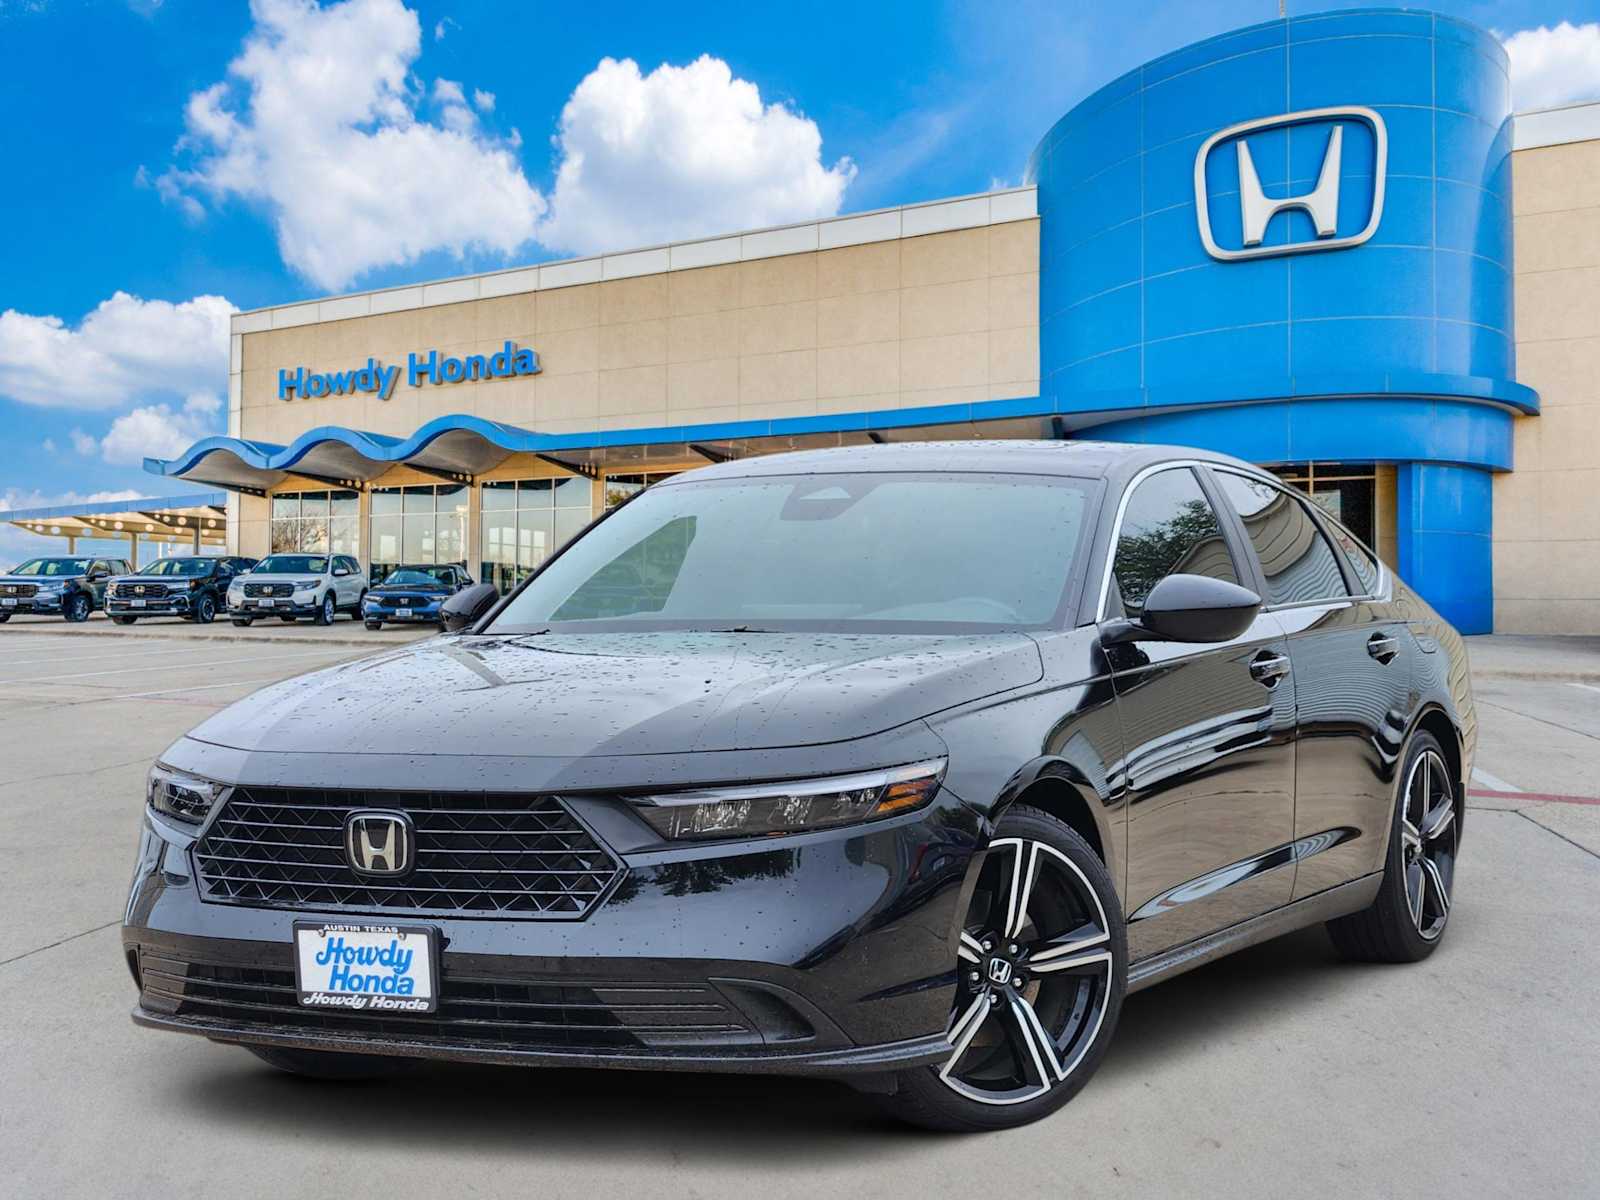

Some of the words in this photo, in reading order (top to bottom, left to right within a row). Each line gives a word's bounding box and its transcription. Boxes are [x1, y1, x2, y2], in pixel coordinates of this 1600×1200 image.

[279, 358, 401, 401] Howdy
[408, 340, 542, 388] Honda
[323, 924, 361, 932] AUSTIN
[364, 925, 399, 933] TEXAS
[316, 937, 414, 975] Howdy
[328, 965, 415, 995] Honda
[303, 992, 368, 1009] Howdy
[369, 996, 429, 1011] Honda
